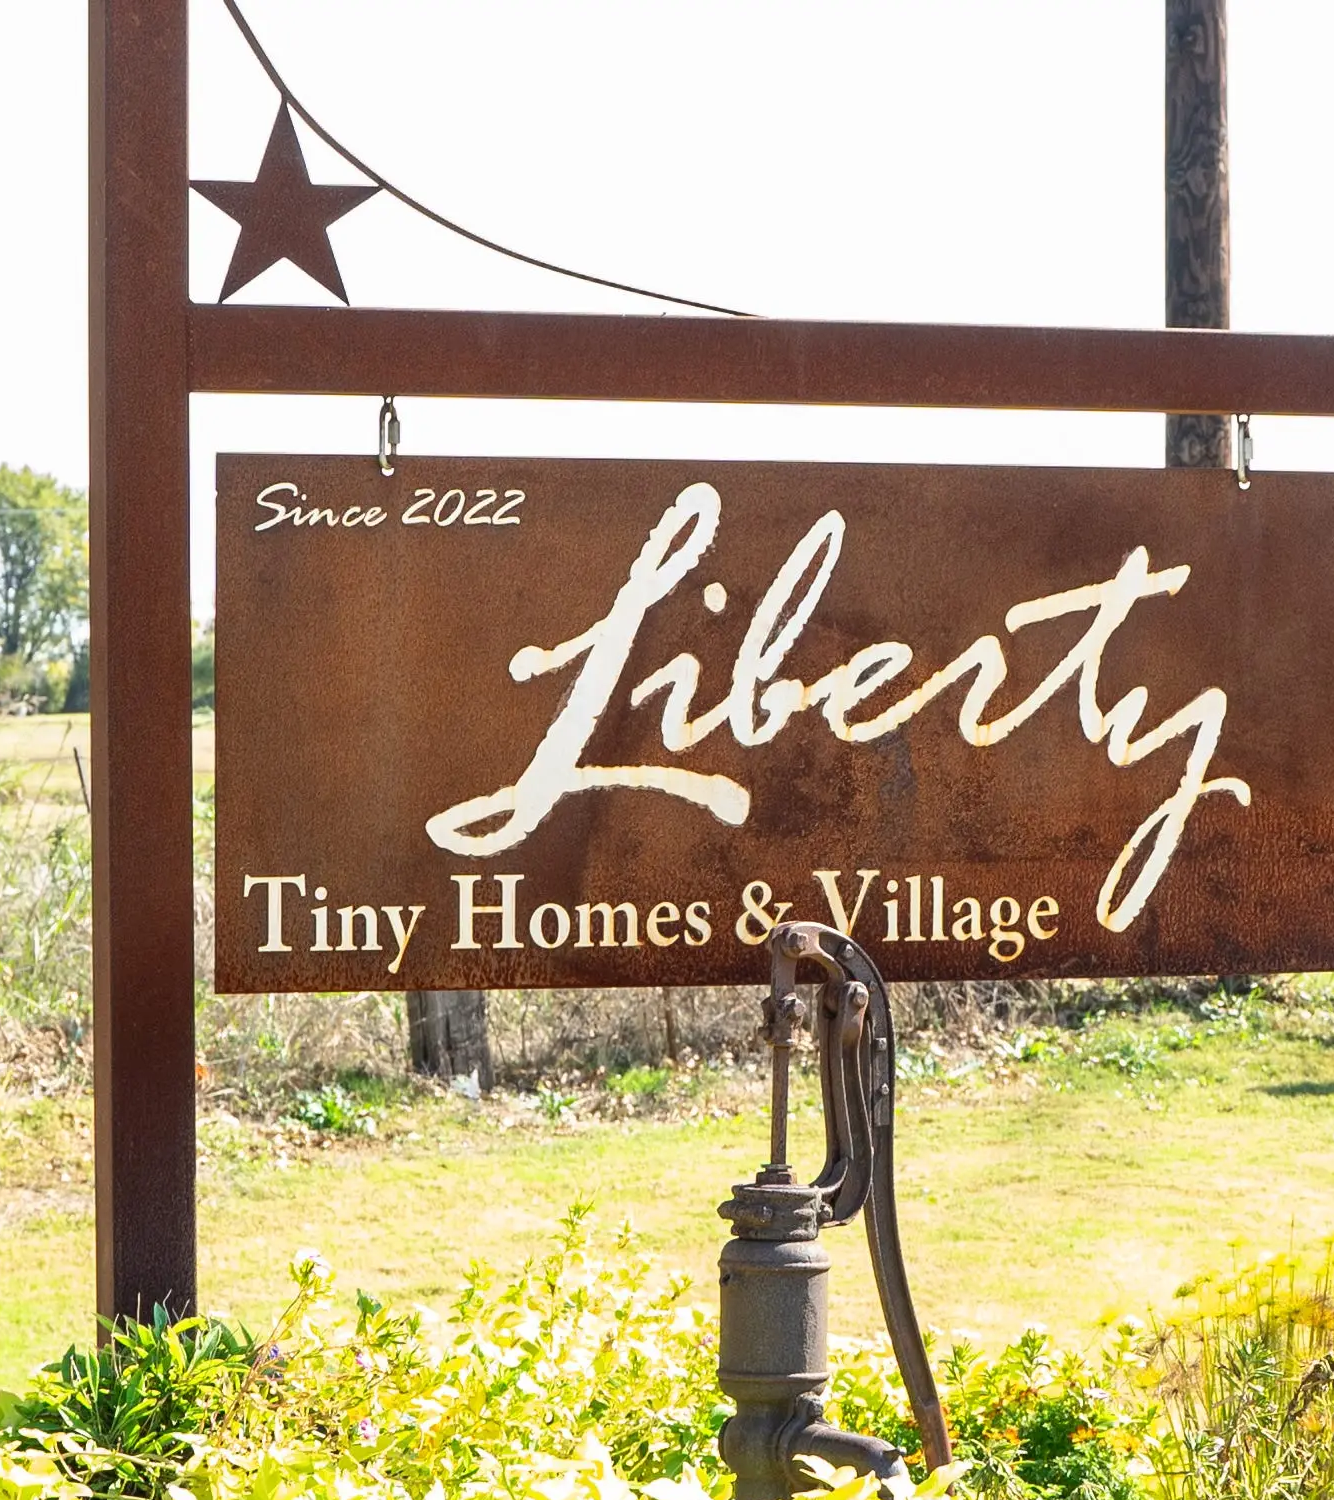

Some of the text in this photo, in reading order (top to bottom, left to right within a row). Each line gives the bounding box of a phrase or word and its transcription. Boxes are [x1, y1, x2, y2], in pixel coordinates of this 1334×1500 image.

[254, 482, 526, 532] Since 2022
[424, 481, 1252, 934] Liberty
[243, 869, 1059, 974] Tiny Homes & Village
